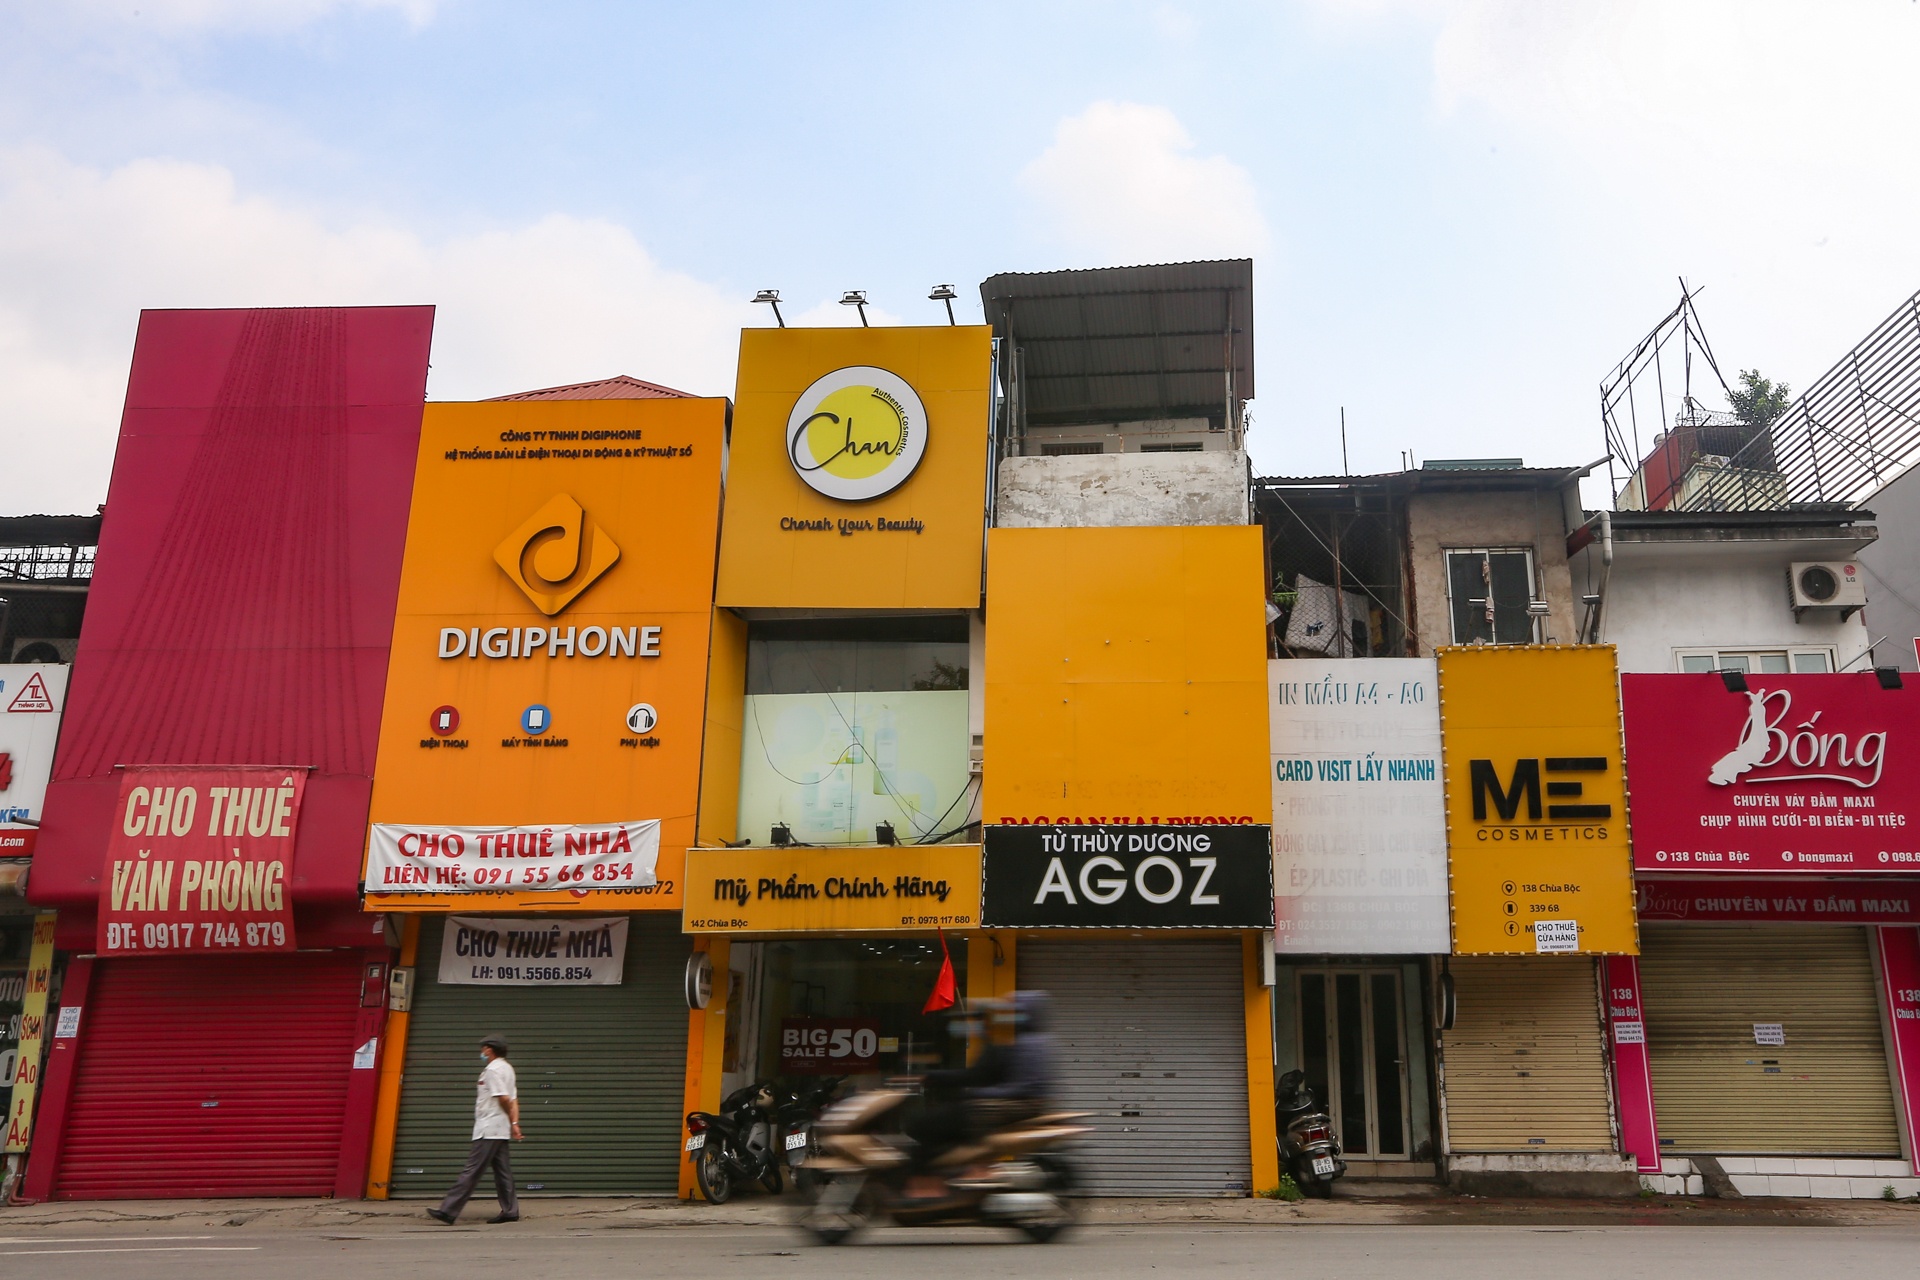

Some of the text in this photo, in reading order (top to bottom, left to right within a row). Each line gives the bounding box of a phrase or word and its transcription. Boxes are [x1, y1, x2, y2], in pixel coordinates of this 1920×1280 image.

[872, 387, 905, 416] Authentic
[500, 429, 642, 441] CÔNG TY TNHH DIGIPHONE
[791, 411, 896, 471] Chan
[895, 415, 909, 457] Cosmetics
[445, 449, 458, 461] HỆ
[459, 446, 492, 459] THỐNG
[494, 447, 514, 459] BÁN
[528, 447, 550, 460] ĐIỆN
[552, 449, 580, 460] THOẠI
[583, 449, 592, 458] DI
[594, 447, 622, 459] ĐỘNG
[624, 449, 632, 458] &
[634, 446, 646, 457] KỸ
[646, 446, 678, 458] THUẬT
[679, 444, 693, 456] SỐ
[780, 516, 924, 536] Cherish Your Beauty
[438, 625, 662, 659] DIGIPHONE
[29, 685, 43, 699] TL
[1279, 683, 1298, 704] IN
[1355, 683, 1379, 705] A4
[420, 737, 468, 749] ĐIỆN THOẠI
[502, 736, 568, 747] MÁY TÍNH BẢNG
[620, 736, 660, 748] PHỤ KIỆN
[1735, 688, 1887, 788] Bống
[1276, 752, 1435, 782] CARD VISIT LẤY NHANH
[1469, 757, 1611, 820] ME
[123, 777, 295, 837] CHO THUÊ
[1734, 792, 1875, 808] CHUYÊN VÁY ĐẦM MAXI
[1700, 815, 1731, 829] CHỤP
[1738, 811, 1767, 827] HÌNH
[1878, 814, 1906, 830] TIỆC
[397, 825, 632, 858] CHO THUÊ NHÀ
[1042, 828, 1211, 852] TỪ THÙY DƯƠNG
[1477, 827, 1608, 841] COSMETICS
[1670, 850, 1750, 863] 138 Chùa Bộc
[1798, 851, 1854, 863] bongmaxi
[111, 848, 284, 912] VĂN PHÒNG
[383, 862, 634, 888] LIÊN HỆ: 091 55 66 854
[1033, 855, 1220, 905] AGOZ
[1291, 863, 1429, 887] ÉP PLASTIC GHI ĐĨA
[714, 873, 952, 906] Mỹ Phẩm Chính Hãng
[1522, 882, 1581, 894] 138 Chùa Bộc
[1529, 905, 1560, 913] 339 68
[1695, 897, 1768, 911] CHUYÊN
[1772, 897, 1807, 911] VÁY
[1813, 896, 1856, 912] ĐẦM
[1862, 899, 1910, 913] MAXI
[691, 918, 748, 929] 142 Chùa Bộc
[901, 915, 970, 925] ĐT: 0978 117 680
[1279, 920, 1295, 931] ĐT:
[1537, 923, 1553, 932] CHO
[1555, 921, 1575, 931] THUÊ
[107, 922, 285, 950] ĐT: 0917 744 879
[456, 924, 612, 958] CHO THUÊ NHÀ
[1537, 932, 1576, 942] CỬA HÀNG
[471, 966, 593, 980] LH: 091.5566.854
[1612, 988, 1633, 1000] 138
[1897, 989, 1920, 1002] 138
[1626, 1006, 1638, 1019] Bộc
[1896, 1008, 1915, 1019] Chùa
[783, 1028, 877, 1058] BIG 50
[782, 1048, 826, 1057] SALE
[6, 1117, 28, 1146] A4
